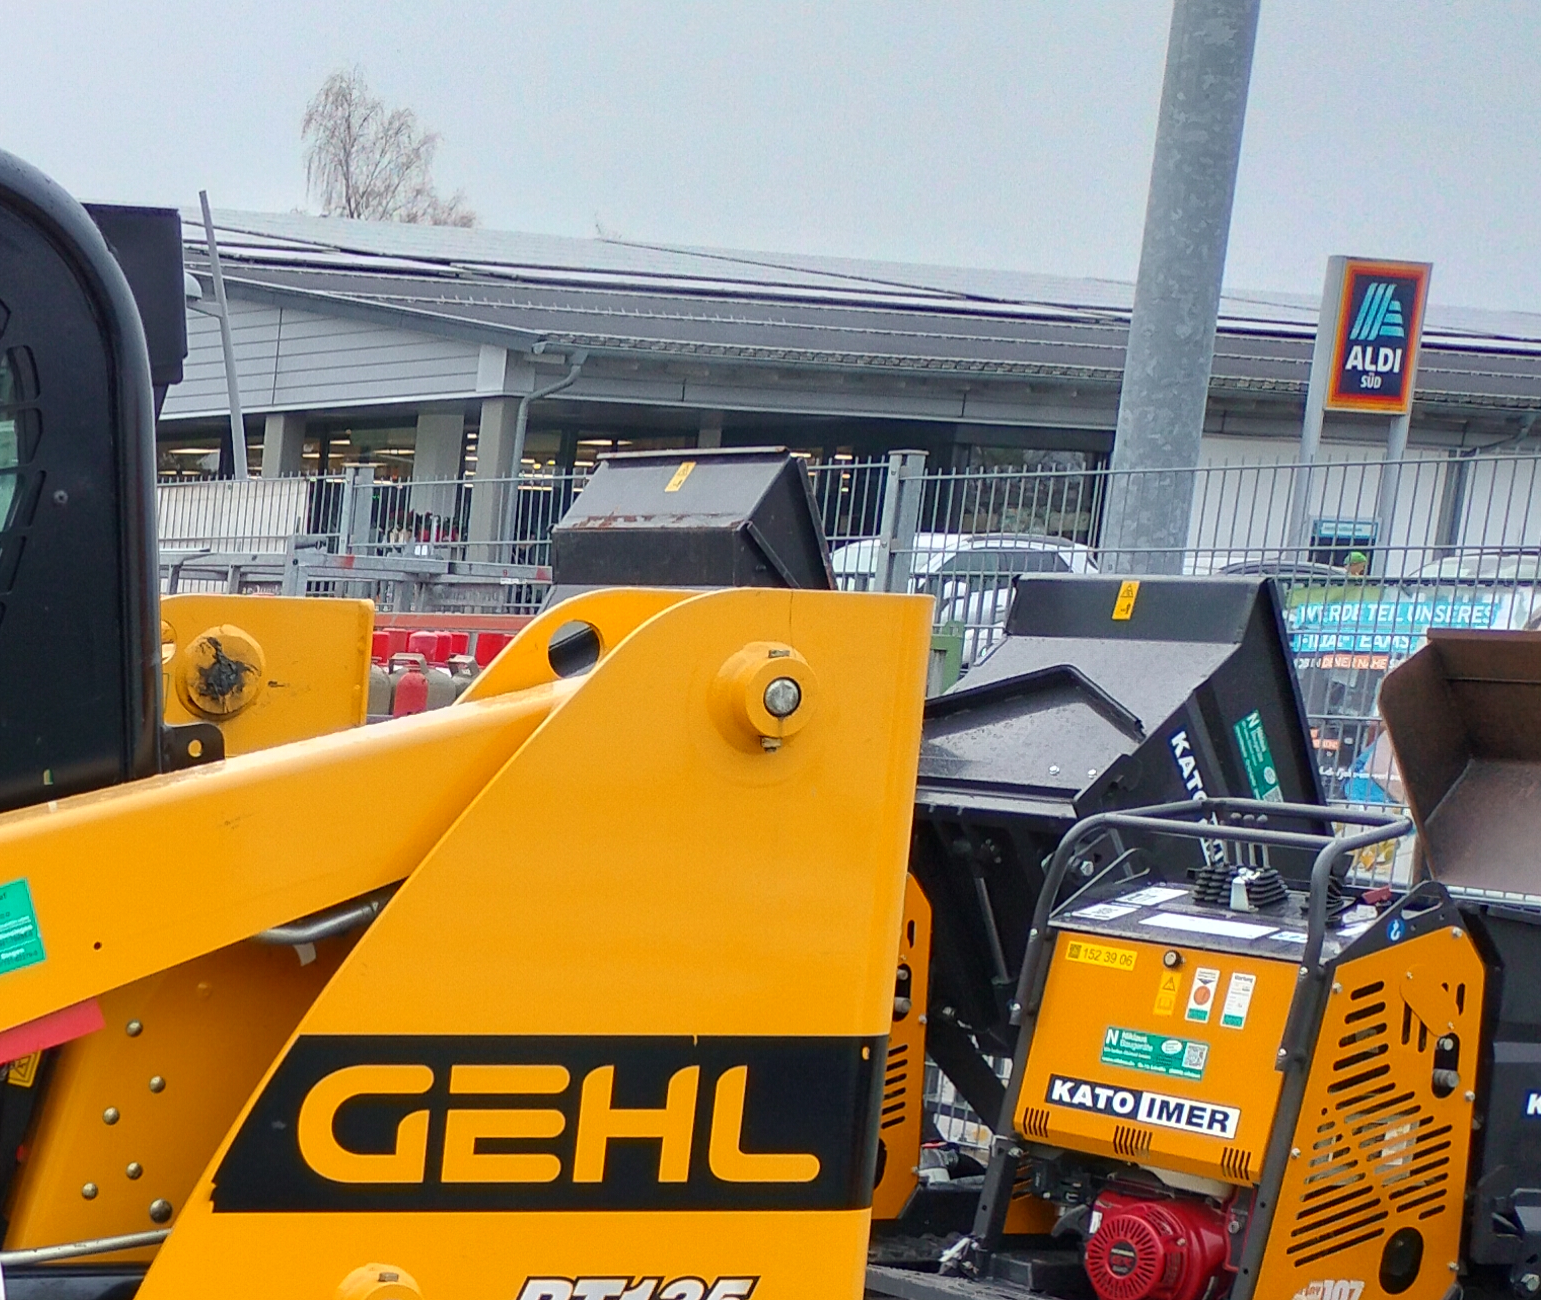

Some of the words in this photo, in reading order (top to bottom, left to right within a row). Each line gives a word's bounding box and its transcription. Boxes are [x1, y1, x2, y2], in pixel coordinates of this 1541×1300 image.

[1345, 345, 1403, 373] ALDI
[1360, 372, 1382, 389] SÜD
[1082, 947, 1100, 962] 152
[1103, 951, 1118, 965] 39
[1119, 954, 1133, 967] 06
[1105, 1028, 1120, 1046] N
[1051, 1078, 1135, 1114] KATO
[1145, 1096, 1231, 1134] IMER
[297, 1064, 821, 1184] GEHL
